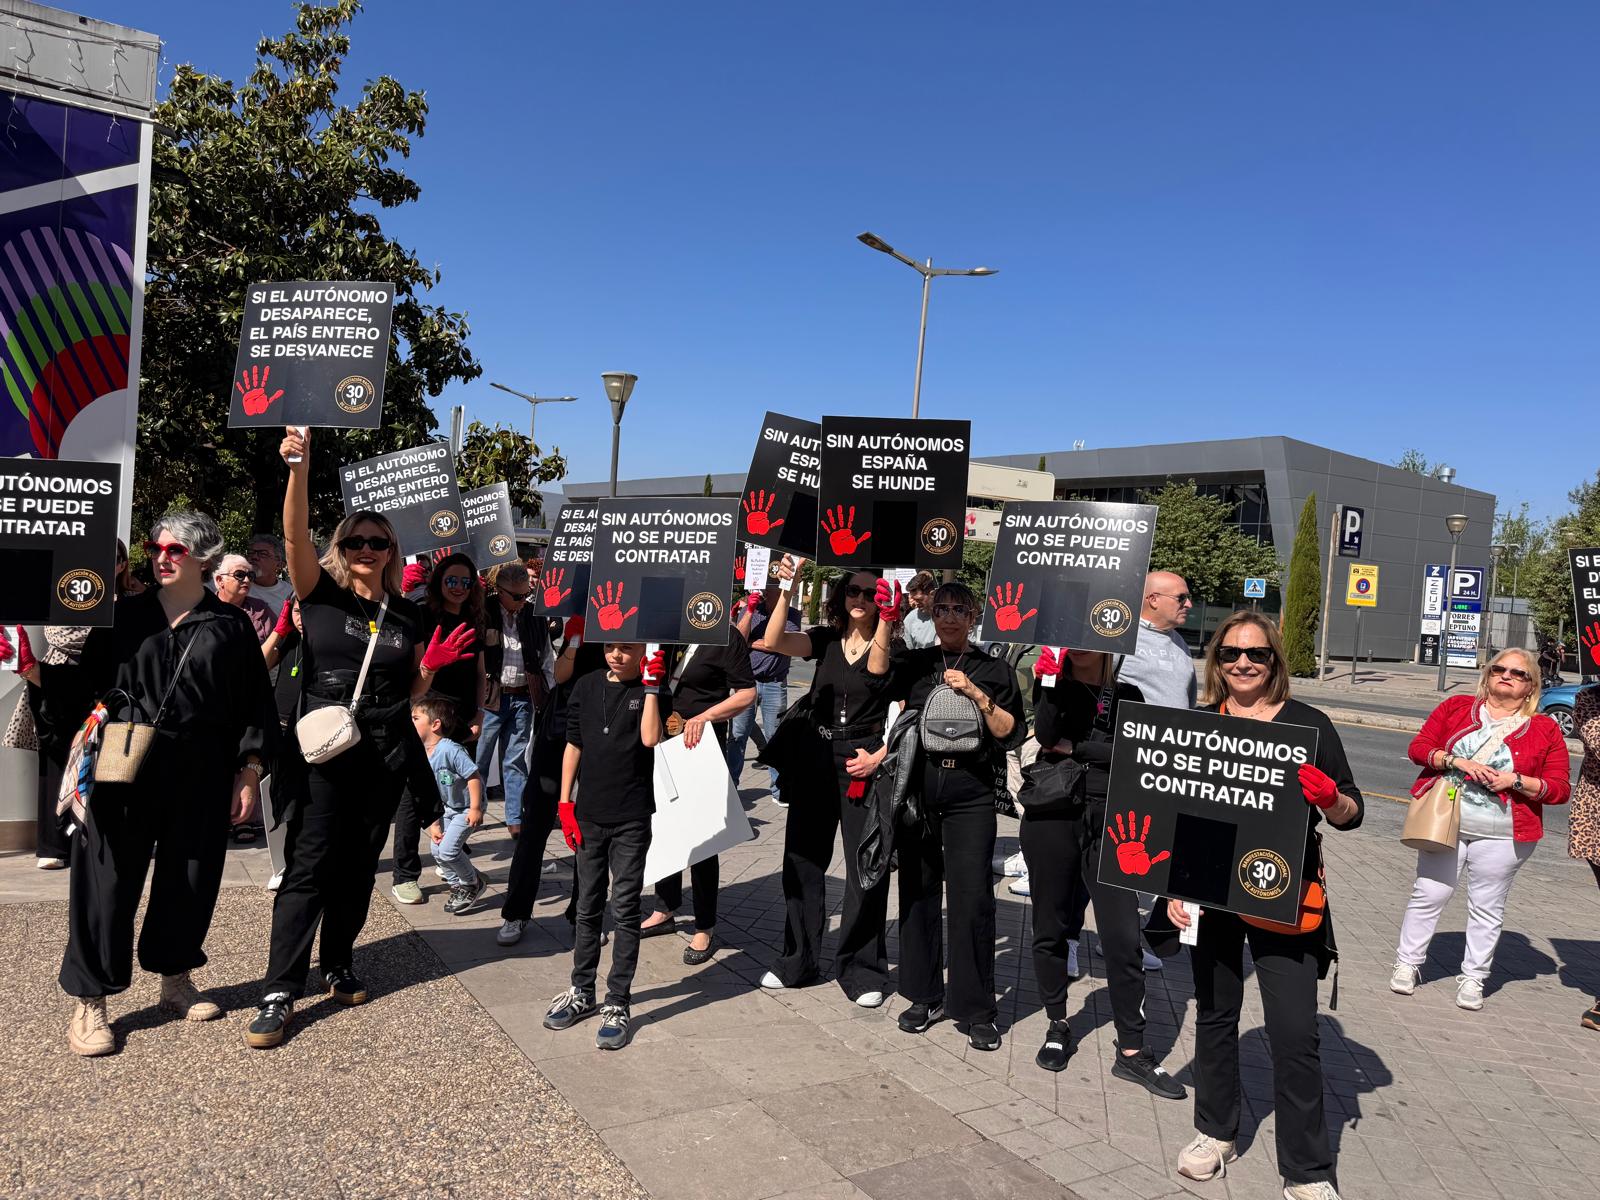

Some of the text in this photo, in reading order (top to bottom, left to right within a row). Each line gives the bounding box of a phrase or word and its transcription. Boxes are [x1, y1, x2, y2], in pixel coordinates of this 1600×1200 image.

[252, 287, 387, 303] SI EL AUTÓNOMO
[261, 308, 372, 323] DESAPARECE,
[250, 323, 380, 340] EL PAÍS ENTERO
[251, 344, 373, 358] SE DESVANECE
[346, 385, 363, 398] 30
[764, 428, 789, 443] SIN
[827, 433, 964, 452] SIN AUTÓNOMOS
[344, 448, 447, 481] SI EL AUTÓNOMO
[862, 454, 927, 470] ESPAÑA
[355, 463, 440, 492] DESAPARECE,
[778, 467, 798, 483] SE
[852, 475, 935, 491] SE HUNDE
[0, 472, 112, 495] TÓNOMOS
[351, 474, 449, 506] EL PAÍS ENTERO
[0, 498, 93, 515] E PUEDE
[375, 488, 449, 513] DESVANECE
[461, 491, 505, 507] ÓNOMOS
[467, 503, 499, 517] PUEDE
[561, 510, 572, 519] SI
[573, 510, 585, 519] EL
[602, 510, 732, 526] SIN AUTÓNOMOS
[0, 519, 85, 536] TRATAR
[437, 517, 451, 527] 30
[465, 514, 497, 528] RATAR
[1006, 514, 1148, 533] SIN AUTÓNOMOS
[1345, 510, 1360, 542] P
[554, 534, 593, 547] EL PAÍS
[612, 531, 717, 544] NO SE PUEDE
[931, 528, 947, 541] 30
[1015, 533, 1130, 550] NO SE PUEDE
[553, 551, 567, 562] SE
[615, 550, 710, 563] CONTRATAR
[1017, 552, 1120, 570] CONTRATAR
[1575, 556, 1589, 567] SI
[1454, 573, 1475, 594] P
[1589, 572, 1600, 583] D
[70, 580, 91, 594] 30
[1583, 588, 1600, 599] EL
[697, 602, 712, 615] 30
[1102, 609, 1120, 622] 30
[1588, 604, 1600, 615] S
[1123, 722, 1307, 764] SIN AUTÓNOMOS
[1137, 748, 1285, 786] NO SE PUEDE
[1140, 773, 1274, 811] CONTRATAR
[1253, 861, 1275, 881] 30
[1259, 879, 1266, 889] N
